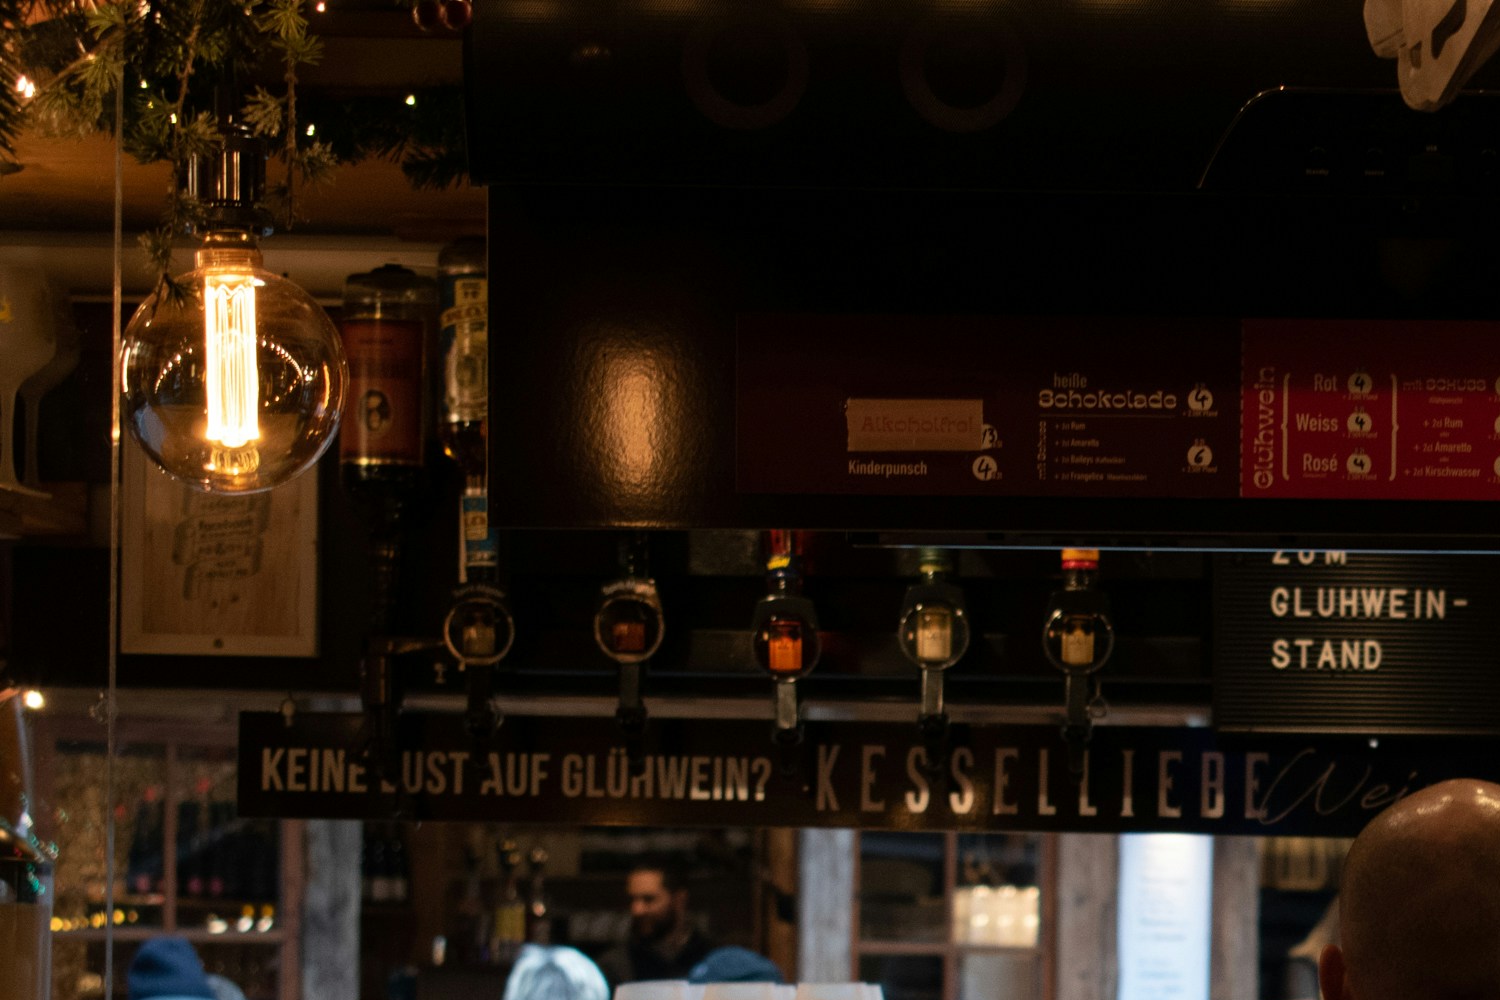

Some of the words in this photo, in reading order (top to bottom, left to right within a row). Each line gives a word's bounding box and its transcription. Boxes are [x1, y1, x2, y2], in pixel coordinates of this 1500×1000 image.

[1053, 371, 1088, 389] heiße
[1313, 372, 1338, 392] Rot
[1038, 388, 1177, 409] Schokolade
[1253, 366, 1275, 489] Glühwein
[1295, 412, 1339, 432] Weiss
[1444, 416, 1464, 429] Rum
[1434, 441, 1473, 454] Amaretto
[849, 459, 928, 478] Kinderpunsch
[1302, 453, 1338, 472] Rosé
[1425, 465, 1482, 478] Kirschwasser
[1271, 638, 1383, 670] STAND
[260, 747, 368, 793] KEINE
[480, 751, 549, 796] AUF
[560, 746, 773, 802] GLÜHWEIN?
[815, 743, 1271, 819] KESSELLIEBE
